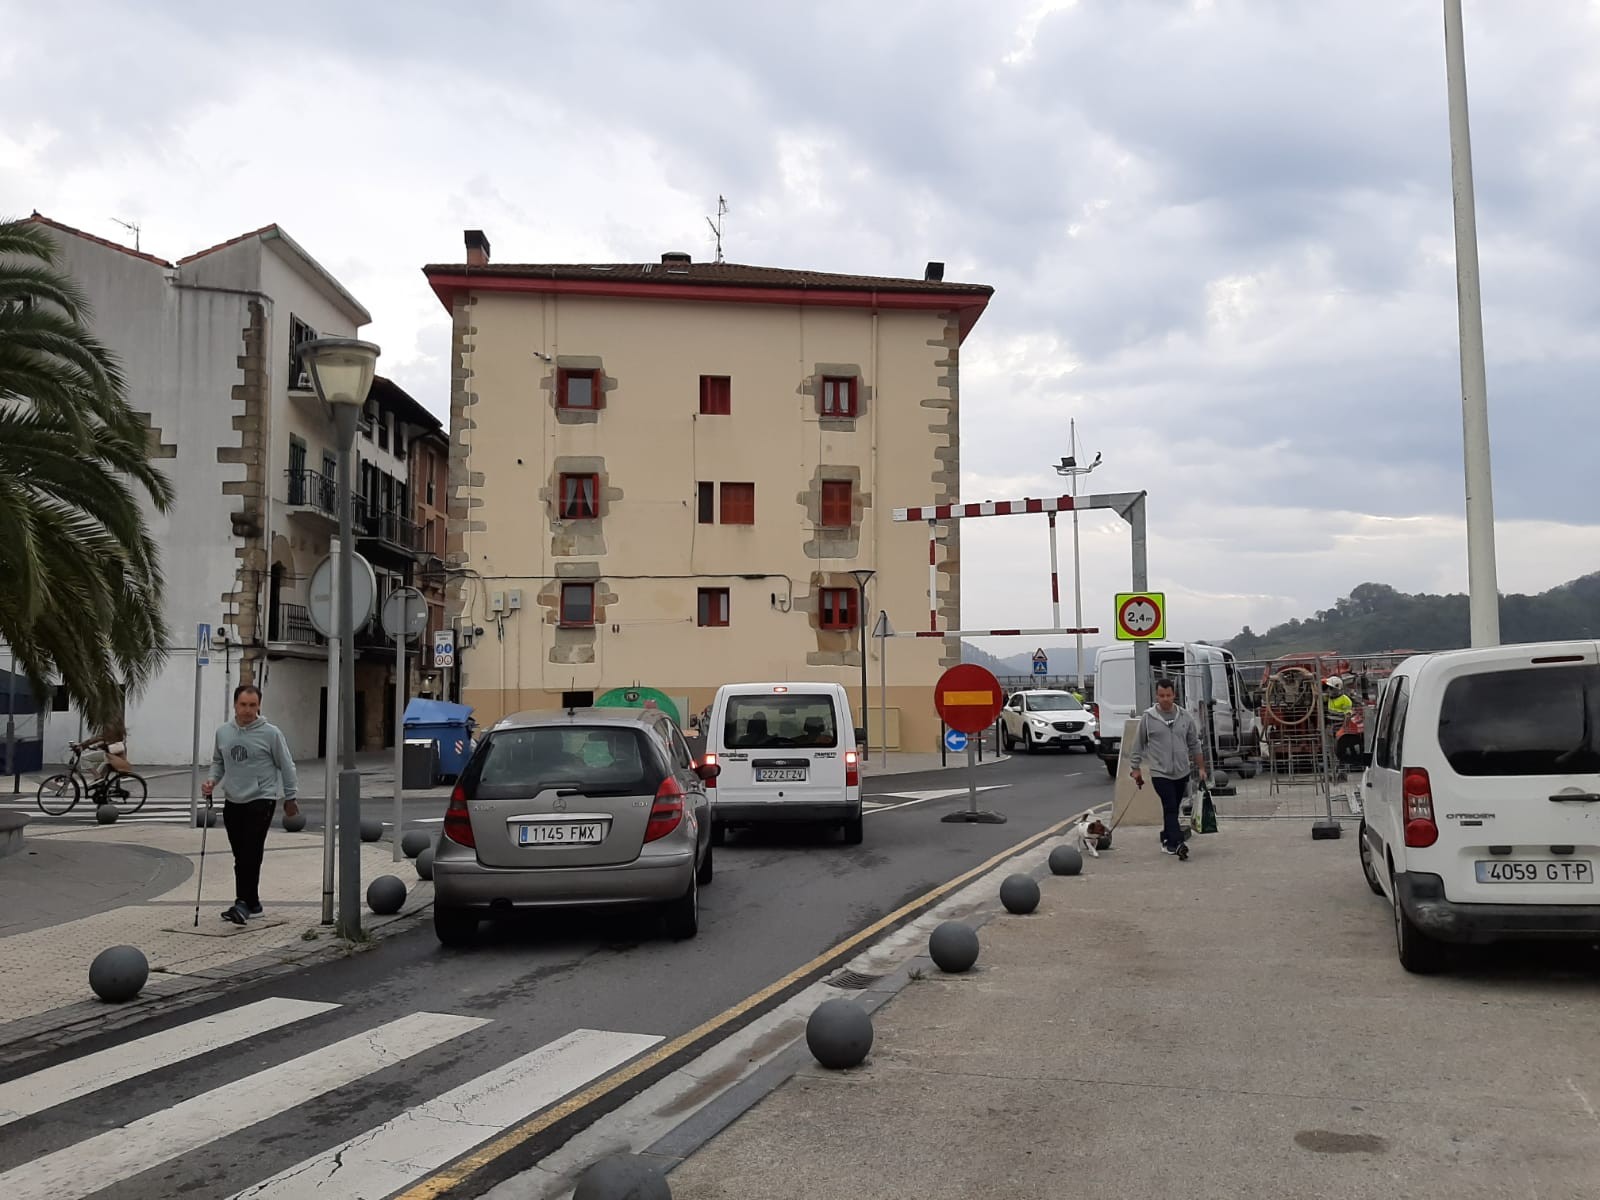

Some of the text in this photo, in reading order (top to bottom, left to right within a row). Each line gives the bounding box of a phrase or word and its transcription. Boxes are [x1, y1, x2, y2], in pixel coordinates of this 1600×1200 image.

[762, 770, 785, 779] 2272
[533, 826, 595, 841] 1145 FMX
[1491, 863, 1588, 881] 4059 GTP
